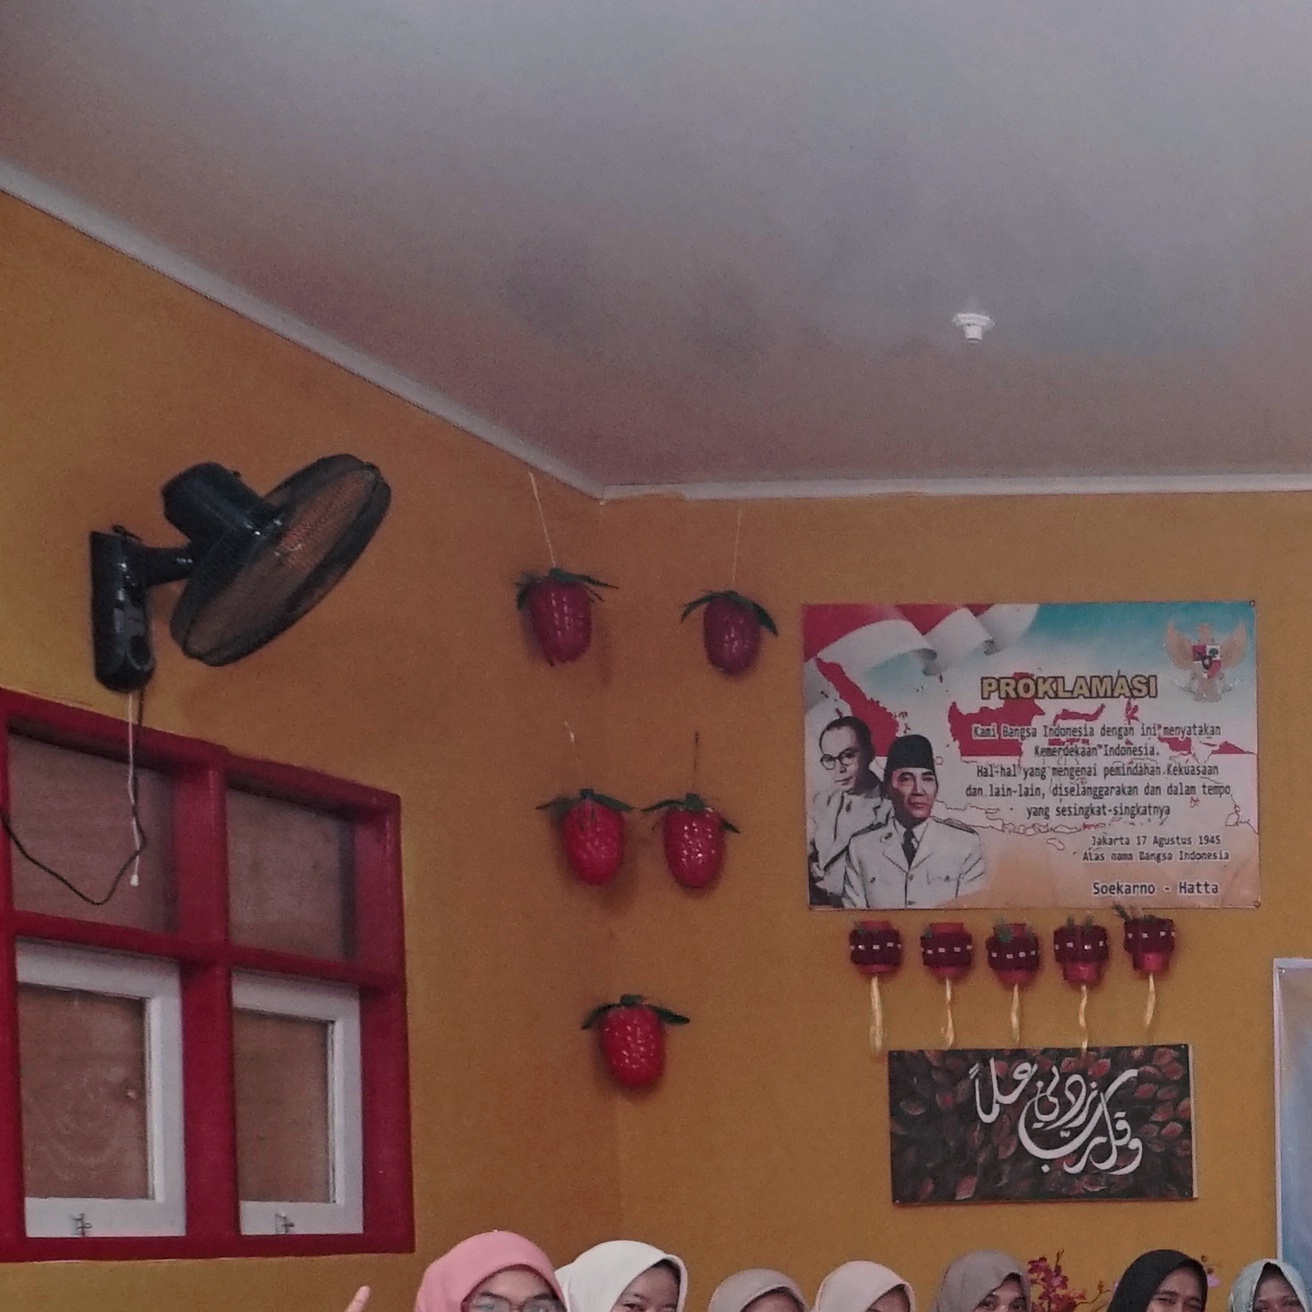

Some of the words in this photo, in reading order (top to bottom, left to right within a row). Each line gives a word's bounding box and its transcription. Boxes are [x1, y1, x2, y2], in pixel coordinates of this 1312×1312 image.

[981, 675, 1158, 700] PROKLAMASI
[973, 725, 996, 737] Kami
[1003, 726, 1037, 740] Bangsa
[1043, 725, 1094, 737] Indonesia
[1100, 724, 1134, 740] dengan
[1141, 724, 1158, 736] ini
[1163, 724, 1221, 739] menyatakan
[1034, 745, 1098, 757] Kemerdekaan
[977, 766, 1017, 777] Hal-hal
[1023, 767, 1046, 779] yang
[1051, 765, 1097, 779] mengenai
[1167, 764, 1219, 776] Kekuasaan
[965, 785, 983, 796] dan
[1052, 784, 1139, 799] diselanggarakan
[1144, 784, 1161, 795] dan
[1167, 784, 1197, 795] dalam
[1202, 784, 1231, 798] tempo
[1026, 807, 1050, 819] yang
[1055, 804, 1171, 819] sesingkat-singkatnya
[1091, 836, 1130, 846] Jakarta
[1136, 835, 1147, 845] 17
[1152, 835, 1192, 847] Agustus
[1198, 835, 1221, 845] 1945
[1179, 850, 1230, 861] Indonesia
[1093, 882, 1156, 895] Soekarno
[1179, 882, 1219, 895] Hatta
